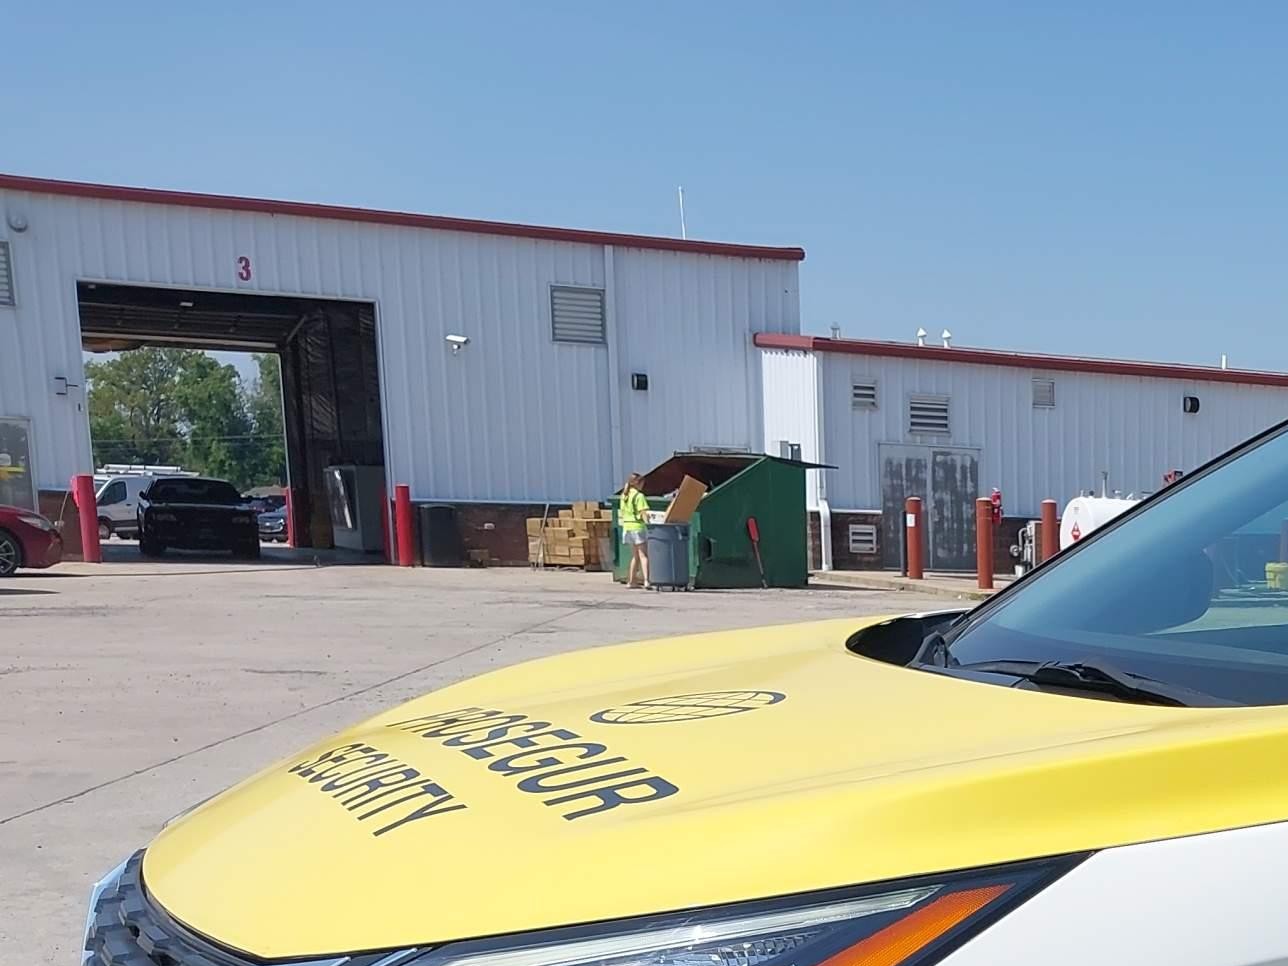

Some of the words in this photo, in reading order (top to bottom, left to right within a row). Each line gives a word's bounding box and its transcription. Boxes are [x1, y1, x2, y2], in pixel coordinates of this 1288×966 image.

[237, 256, 251, 281] 3
[287, 742, 468, 837] SECURITY
[385, 707, 680, 821] PROSEGUR
